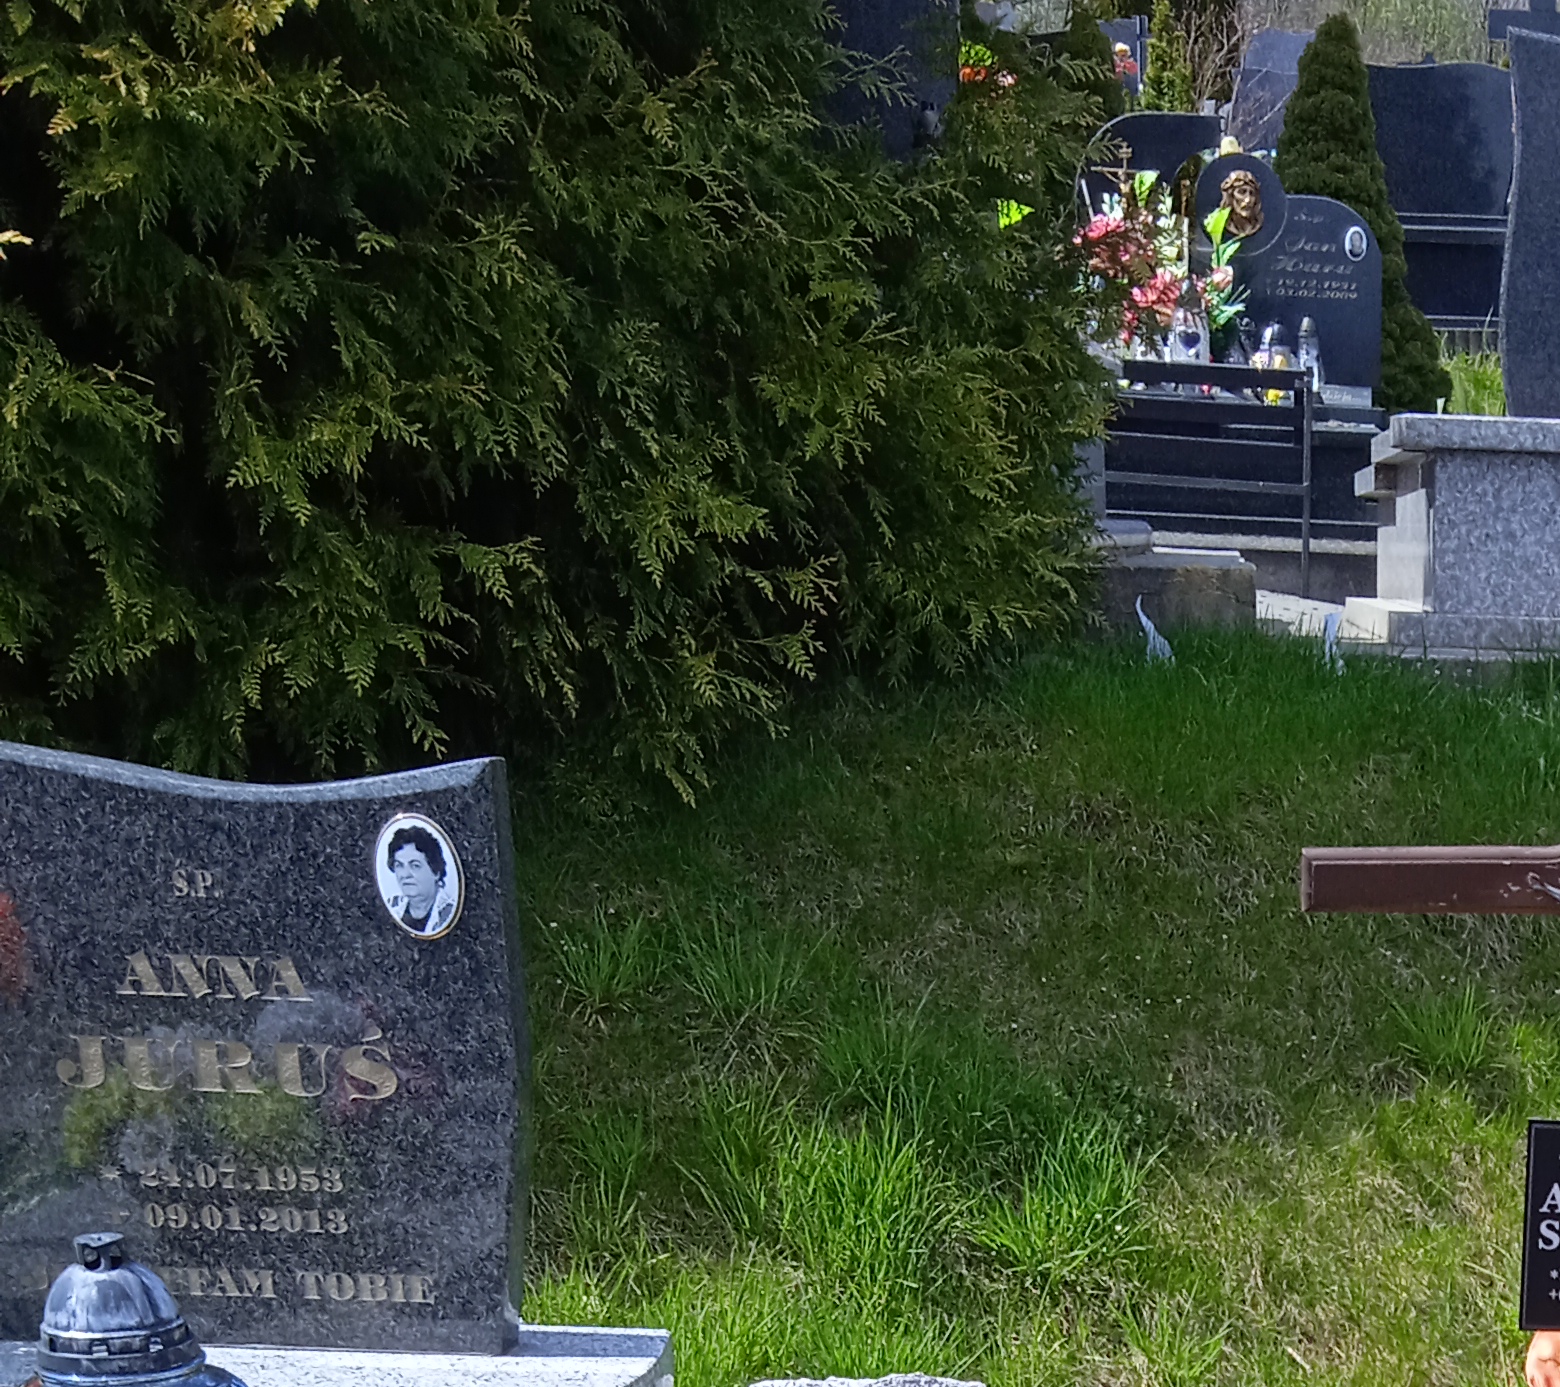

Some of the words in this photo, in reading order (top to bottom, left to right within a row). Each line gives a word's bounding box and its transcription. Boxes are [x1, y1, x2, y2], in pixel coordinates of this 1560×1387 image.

[116, 950, 313, 1001] ANNA
[56, 1026, 398, 1100] JURUŚ
[145, 1202, 349, 1234] 09.01.2013
[296, 1271, 436, 1304] TOBIE
